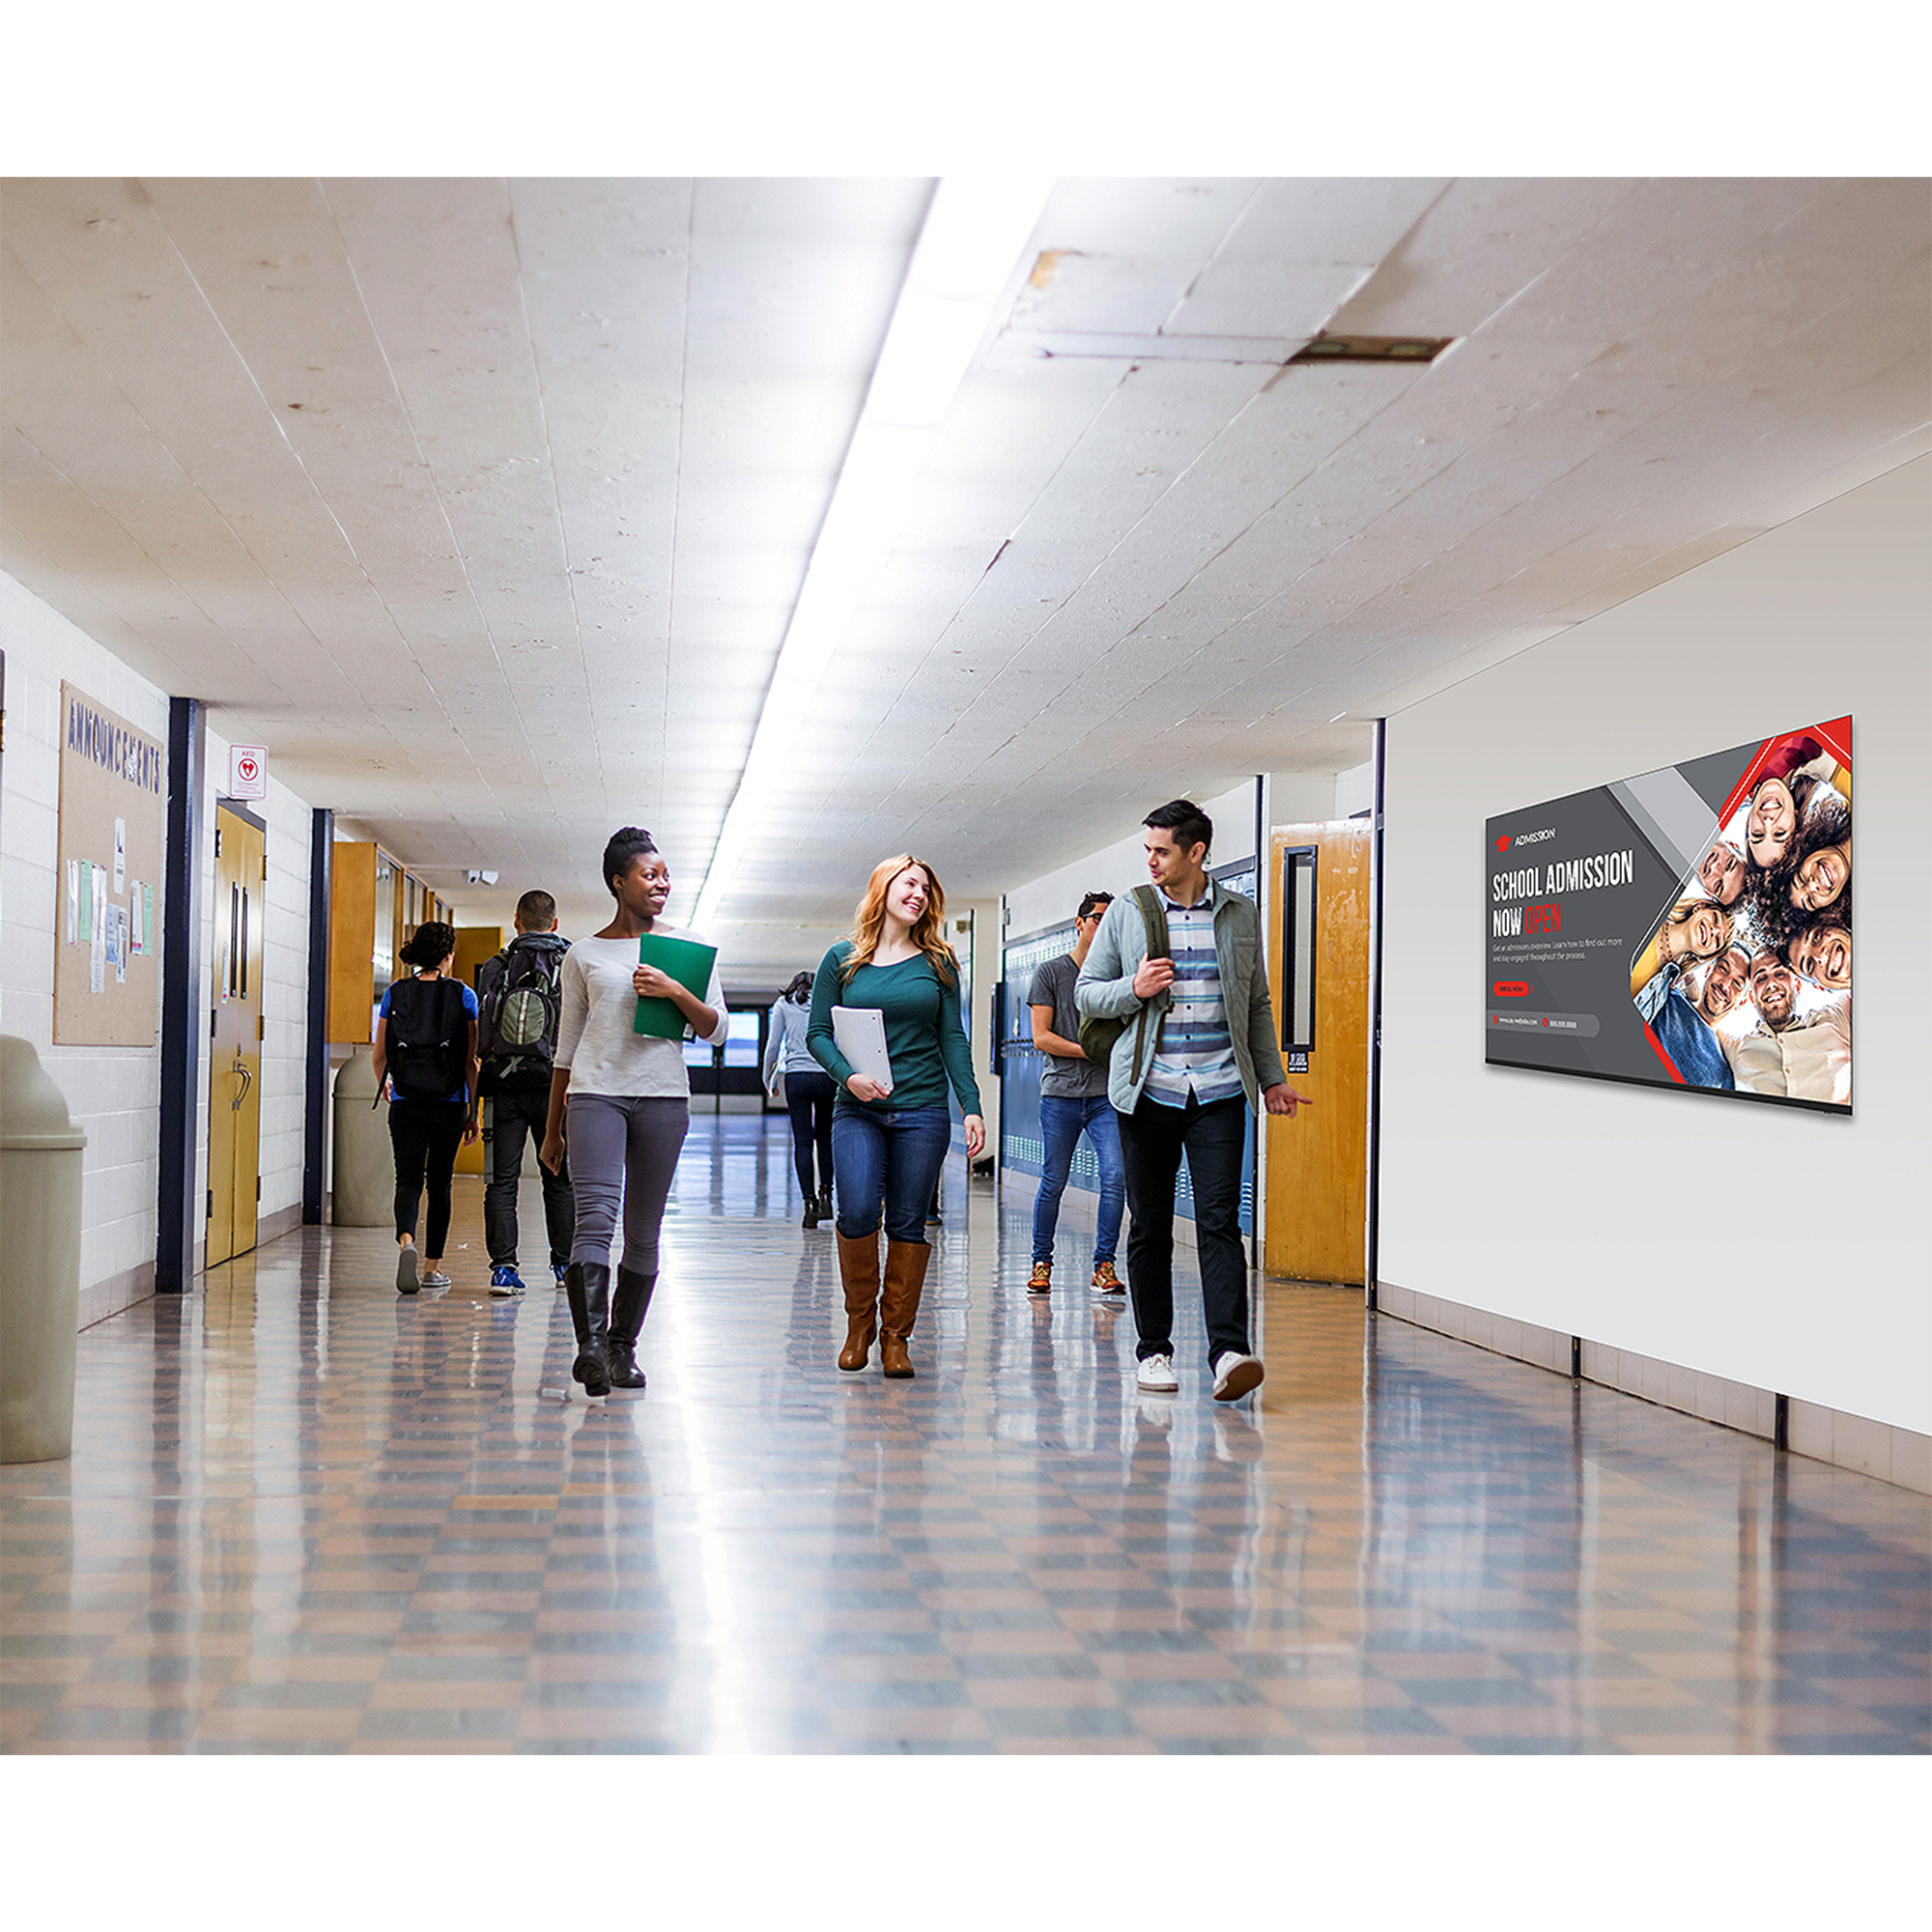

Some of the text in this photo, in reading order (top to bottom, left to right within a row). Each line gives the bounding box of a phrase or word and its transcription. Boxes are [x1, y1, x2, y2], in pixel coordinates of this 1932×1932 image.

[68, 697, 159, 794] ANNOUNCEMENTS
[1515, 828, 1556, 847] ADMISSION
[1492, 849, 1634, 902] SCHOOL ADMISSION
[1492, 902, 1562, 938] NOW OPEN
[1585, 938, 1596, 947] find
[1607, 938, 1623, 947] more
